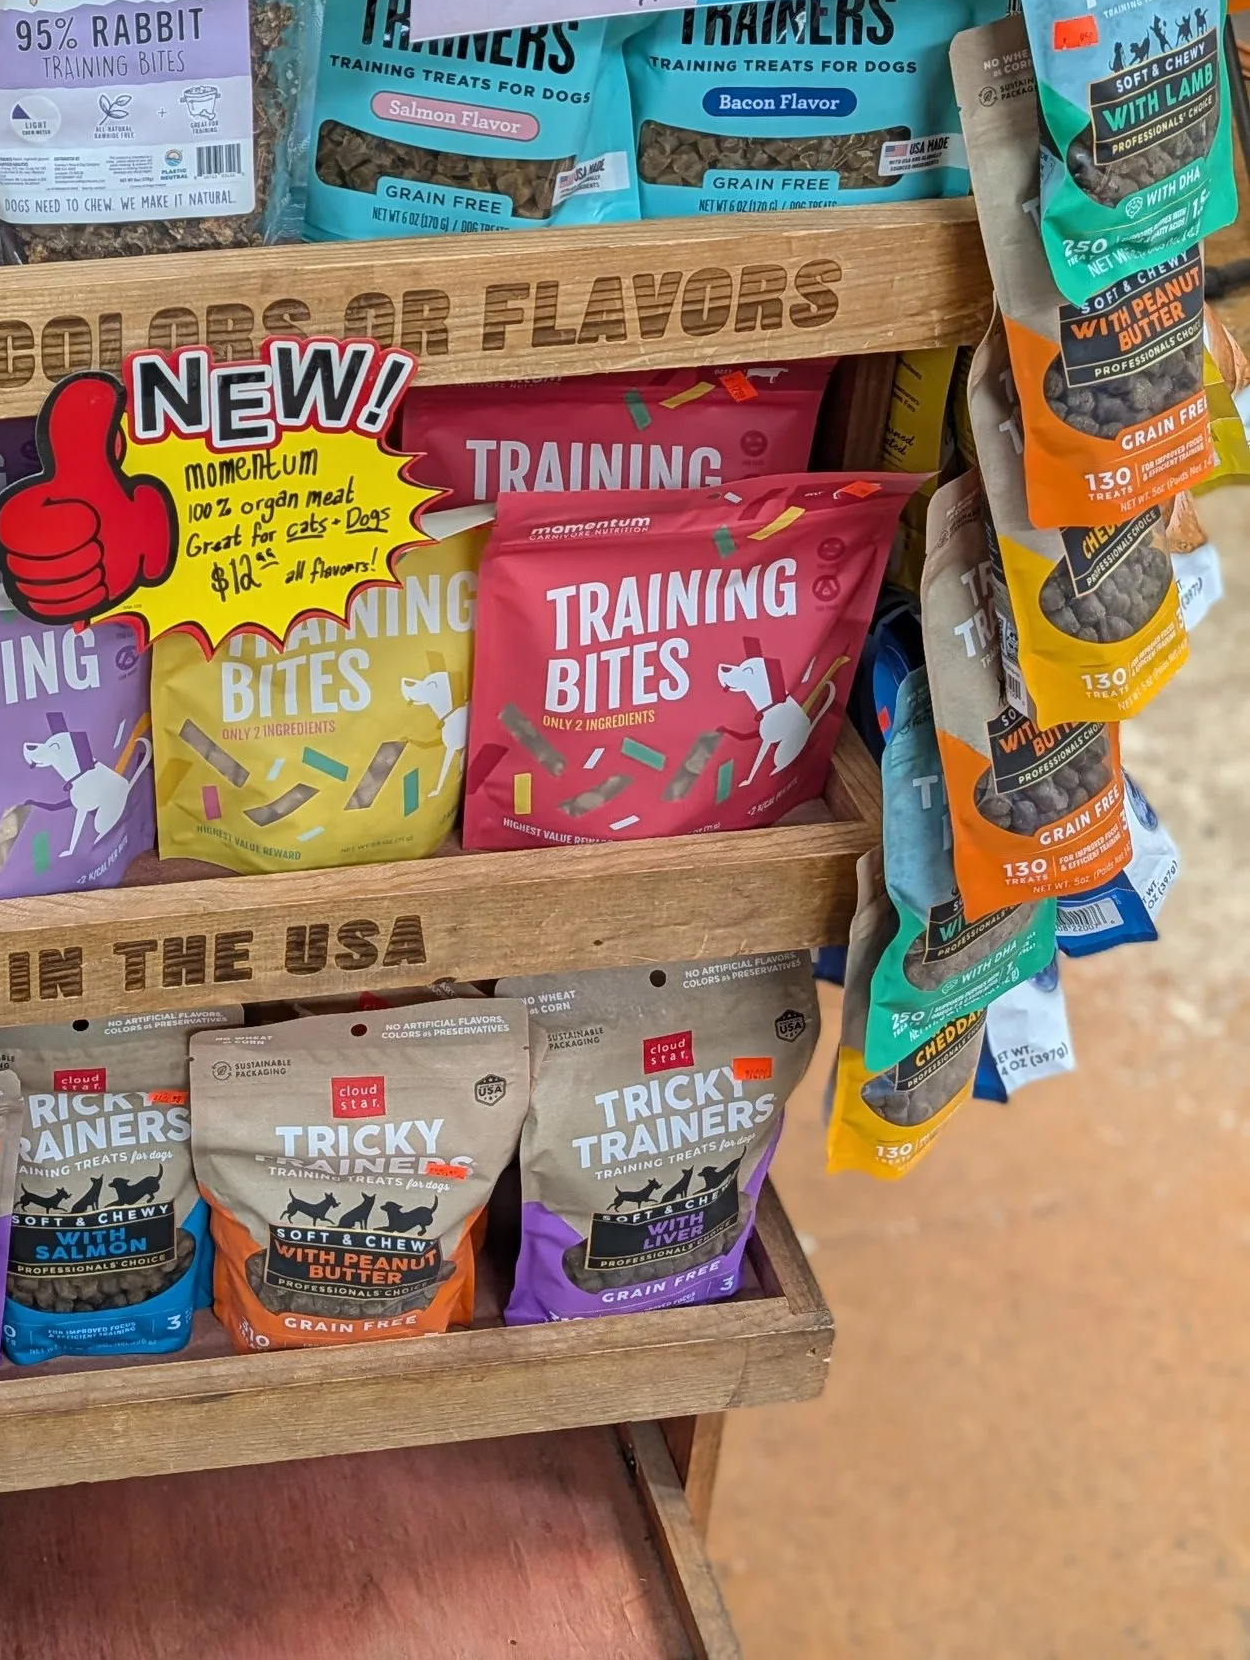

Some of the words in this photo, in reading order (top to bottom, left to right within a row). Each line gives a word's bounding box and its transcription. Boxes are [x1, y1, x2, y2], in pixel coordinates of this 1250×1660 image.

[15, 16, 78, 53] 95%
[90, 7, 204, 49] RABBIT
[43, 54, 132, 81] TRAINING
[140, 52, 185, 77] BITES
[650, 56, 738, 73] TRAINING
[744, 58, 814, 73] TREATS
[821, 59, 858, 73] FOR
[863, 59, 917, 73] DOGS
[719, 93, 777, 111] Bacon
[781, 93, 840, 111] Flavor
[1102, 94, 1160, 132] WITH
[1164, 66, 1214, 108] LAMB
[388, 99, 460, 125] Salmon
[464, 108, 522, 136] Flavor
[712, 175, 774, 191] GRAIN
[781, 175, 830, 191] FREE
[345, 290, 450, 357] OR
[483, 259, 843, 352] FLAVORS
[185, 448, 318, 491] momentum
[1084, 466, 1132, 492] 130
[189, 497, 232, 523] 100%
[241, 493, 299, 523] organ
[306, 476, 354, 505] meat
[186, 531, 242, 557] Great
[252, 521, 277, 545] for
[286, 513, 327, 542] cats
[345, 506, 390, 533] Dogs
[285, 560, 305, 584] all
[546, 559, 798, 651] TRAINING
[546, 637, 691, 715] BITES
[543, 715, 570, 731] ONLY
[572, 714, 581, 729] 2
[584, 709, 656, 730] INGREDIENTS
[7, 947, 84, 1003] IN
[112, 930, 254, 992] THE
[284, 915, 427, 976] USA
[274, 1119, 444, 1159] TRICKY
[34, 1238, 148, 1259] SALMON
[276, 1243, 340, 1266] WITH
[343, 1246, 437, 1270] PEANUT
[309, 1264, 403, 1285] BUTTER
[284, 1316, 358, 1334] GRAIN
[364, 1314, 418, 1332] FREE
